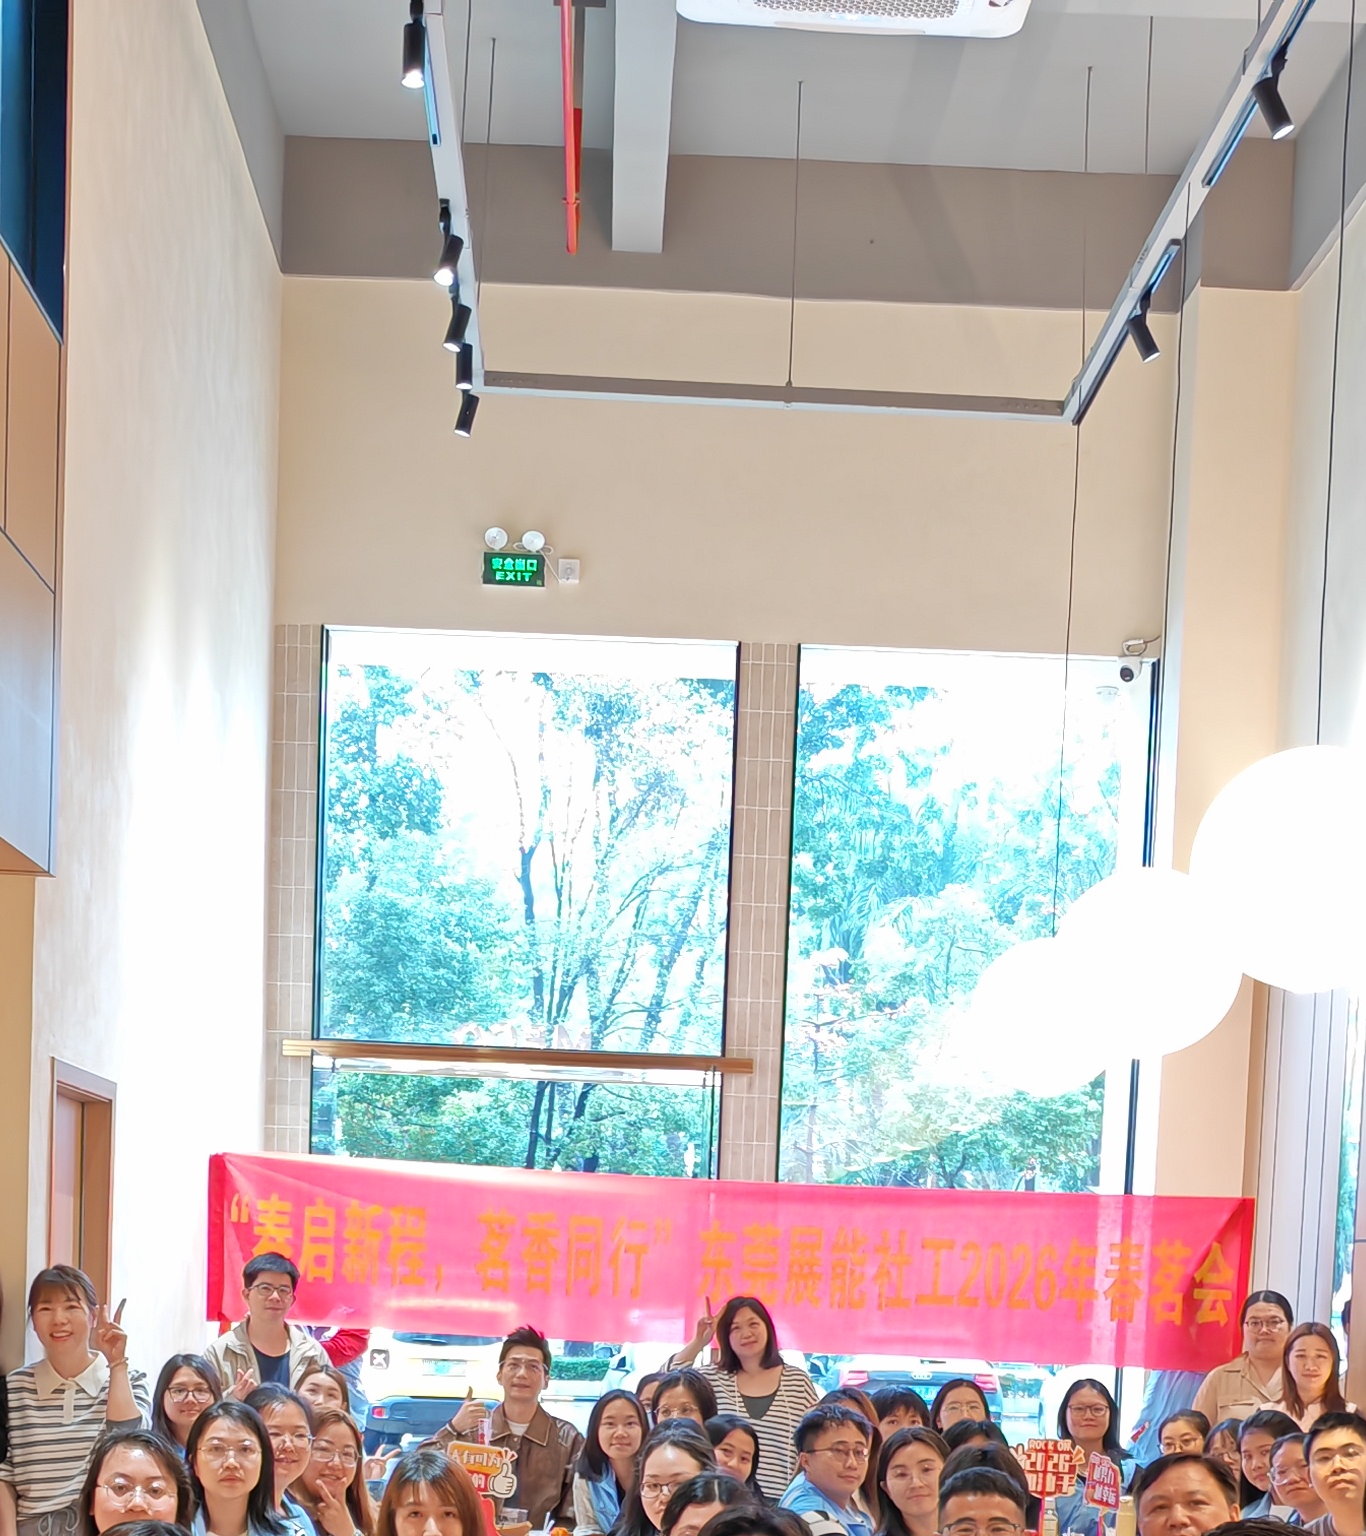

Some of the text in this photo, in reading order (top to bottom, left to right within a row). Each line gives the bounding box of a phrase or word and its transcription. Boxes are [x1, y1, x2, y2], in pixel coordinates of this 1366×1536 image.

[491, 557, 538, 571] 安全出口
[495, 571, 533, 582] EXIT
[1028, 1440, 1072, 1451] ROCK ON
[1026, 1451, 1071, 1473] 2026
